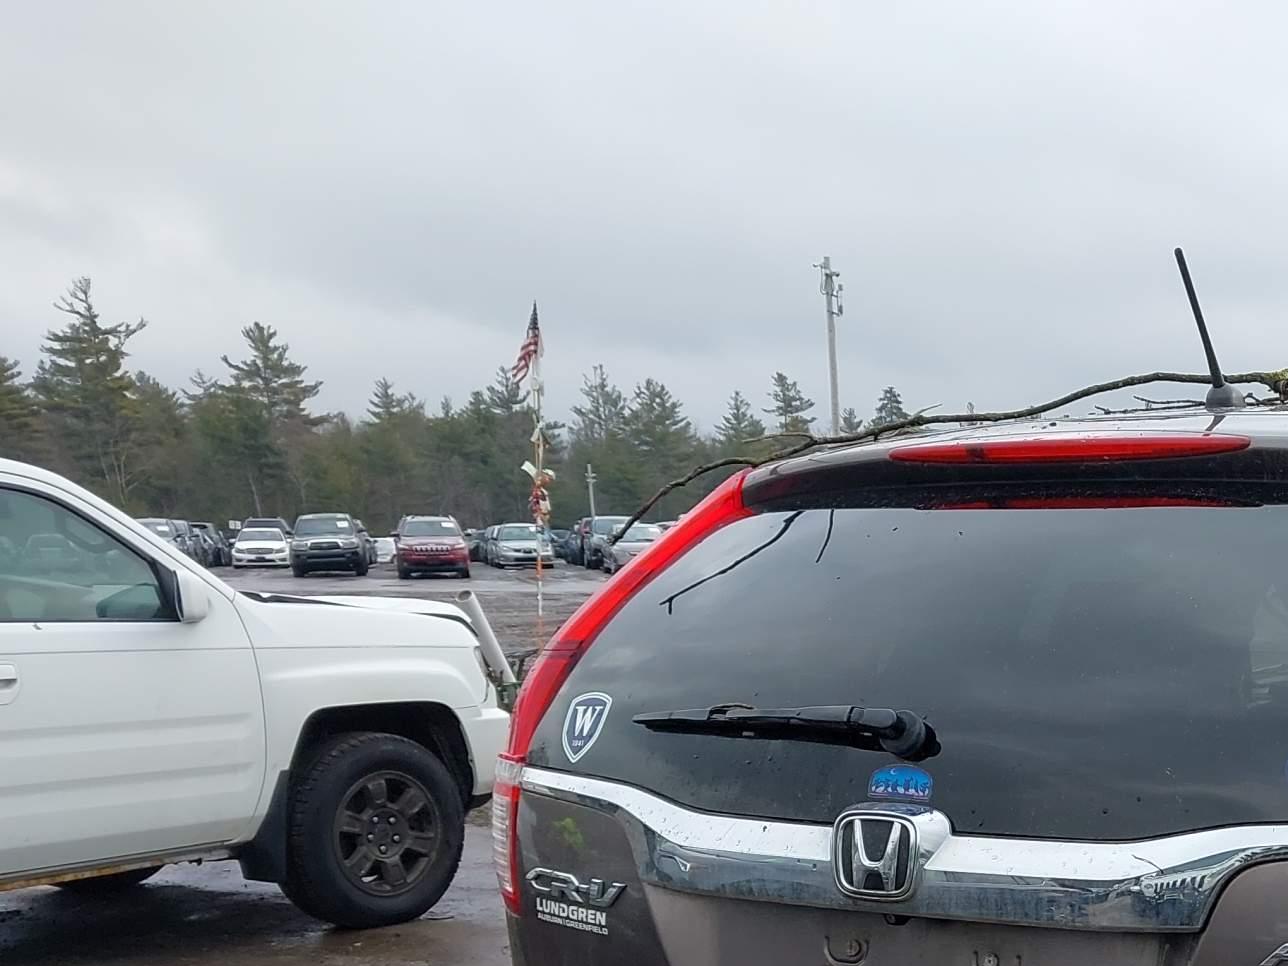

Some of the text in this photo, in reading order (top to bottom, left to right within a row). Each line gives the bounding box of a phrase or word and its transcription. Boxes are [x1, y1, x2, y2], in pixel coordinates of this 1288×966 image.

[574, 705, 604, 737] W
[525, 867, 627, 907] CR-V
[536, 897, 607, 925] LUNDGREN
